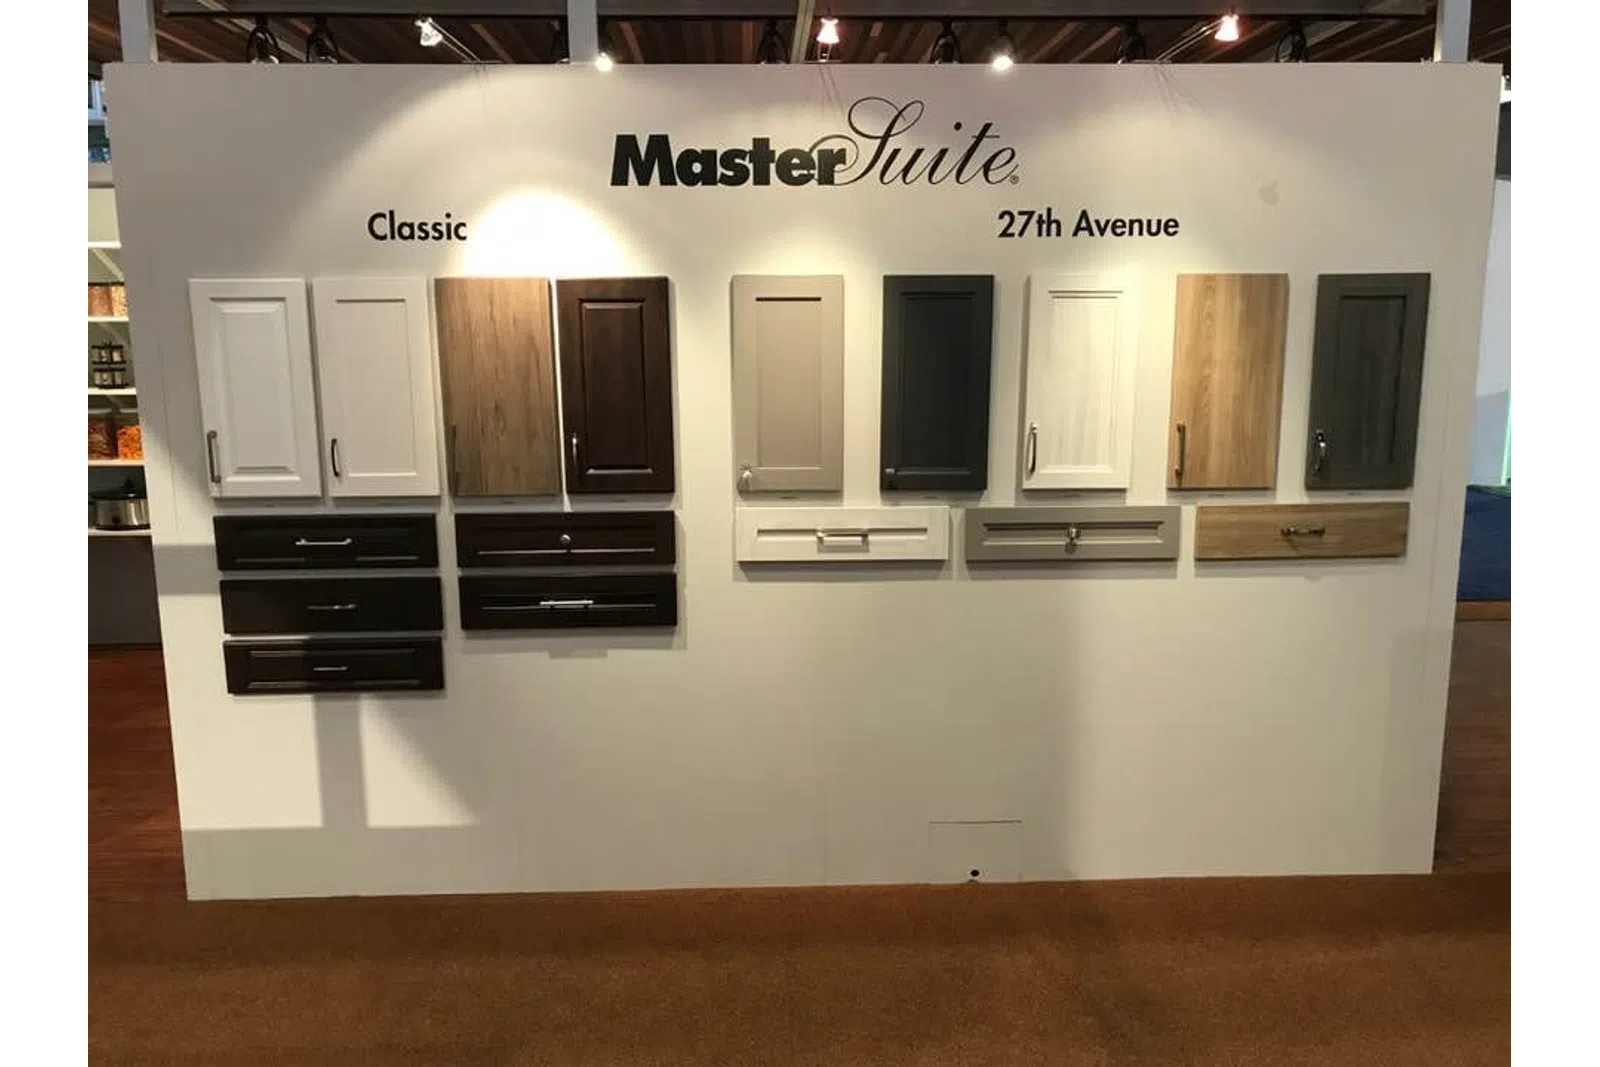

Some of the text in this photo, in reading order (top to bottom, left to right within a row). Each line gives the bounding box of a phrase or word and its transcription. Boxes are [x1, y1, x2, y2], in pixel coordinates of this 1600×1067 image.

[367, 209, 467, 241] Classic
[997, 206, 1180, 238] 27th Avenue
